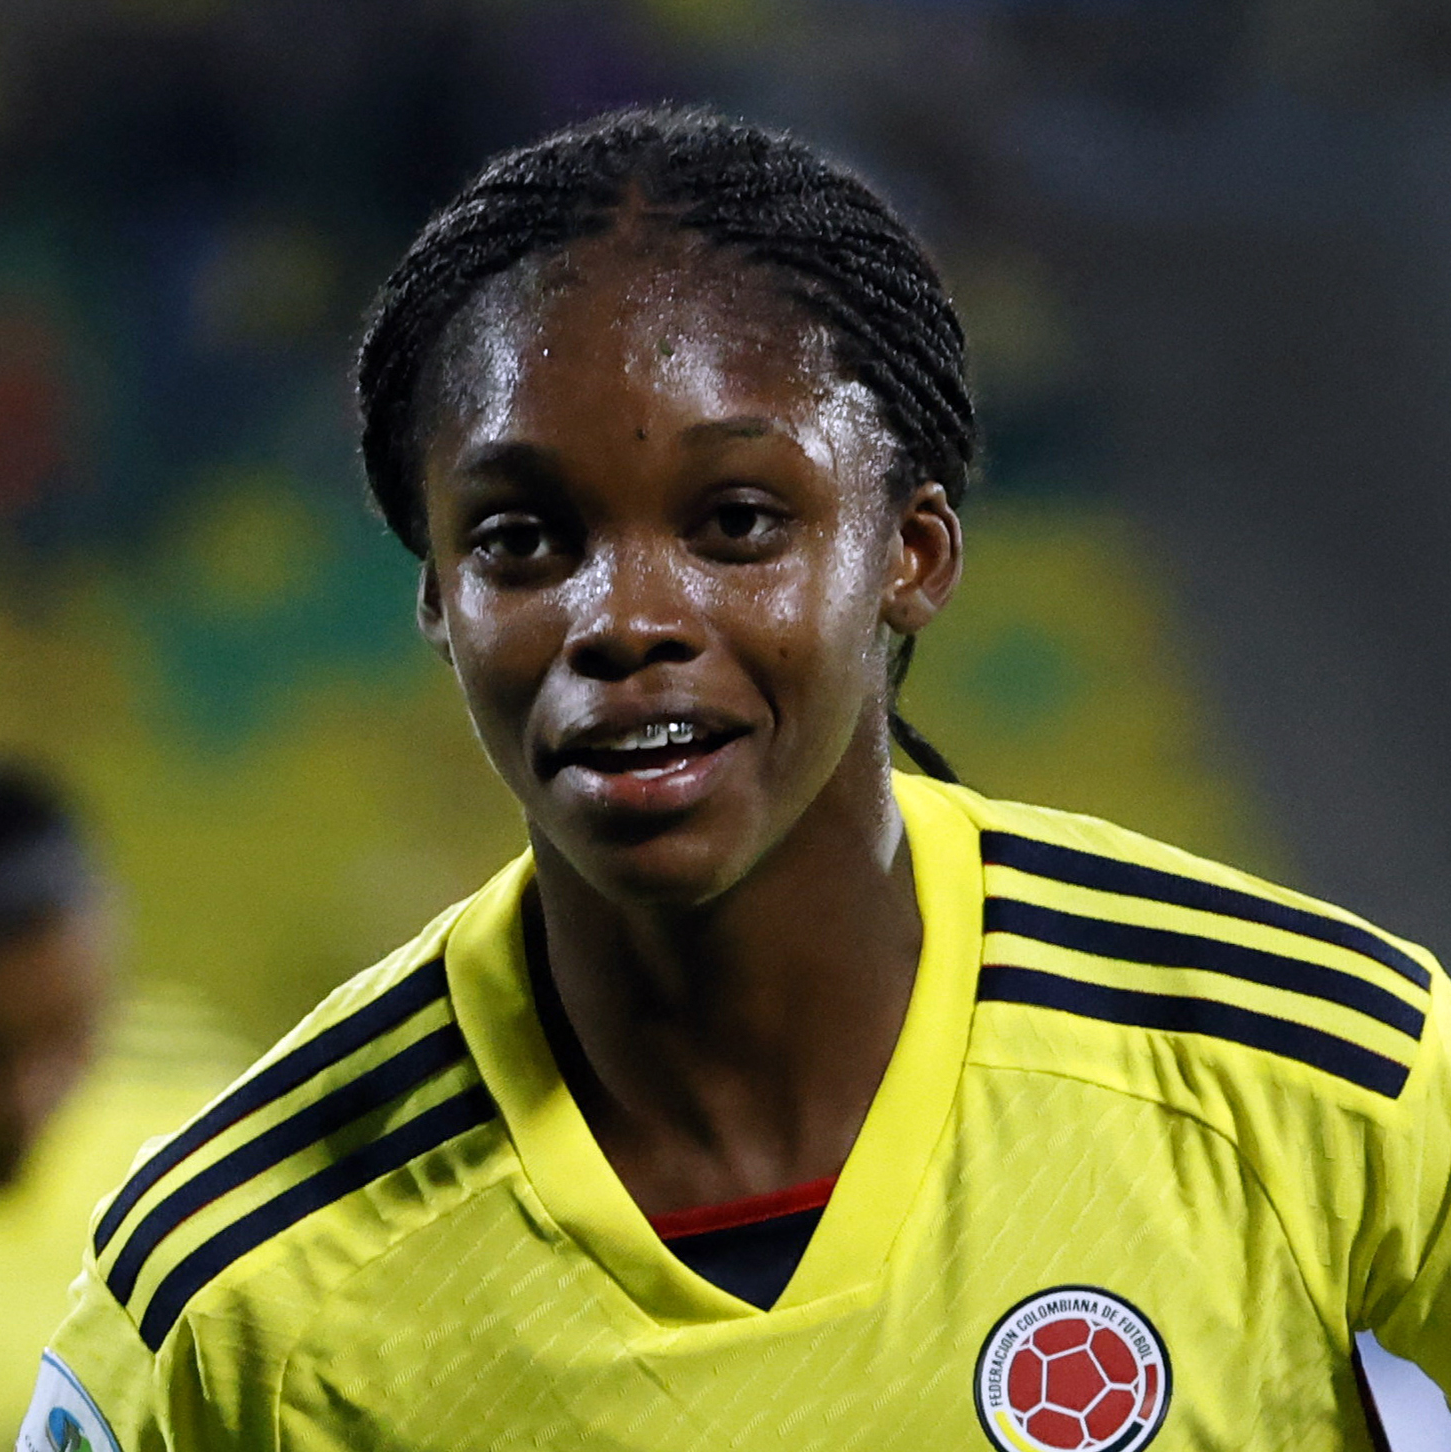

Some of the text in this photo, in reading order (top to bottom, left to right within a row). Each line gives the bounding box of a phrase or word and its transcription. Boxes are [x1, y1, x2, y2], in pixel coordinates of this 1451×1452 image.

[988, 1298, 1153, 1408] FEDERACION COLOMBIANA DE FUTBOL
